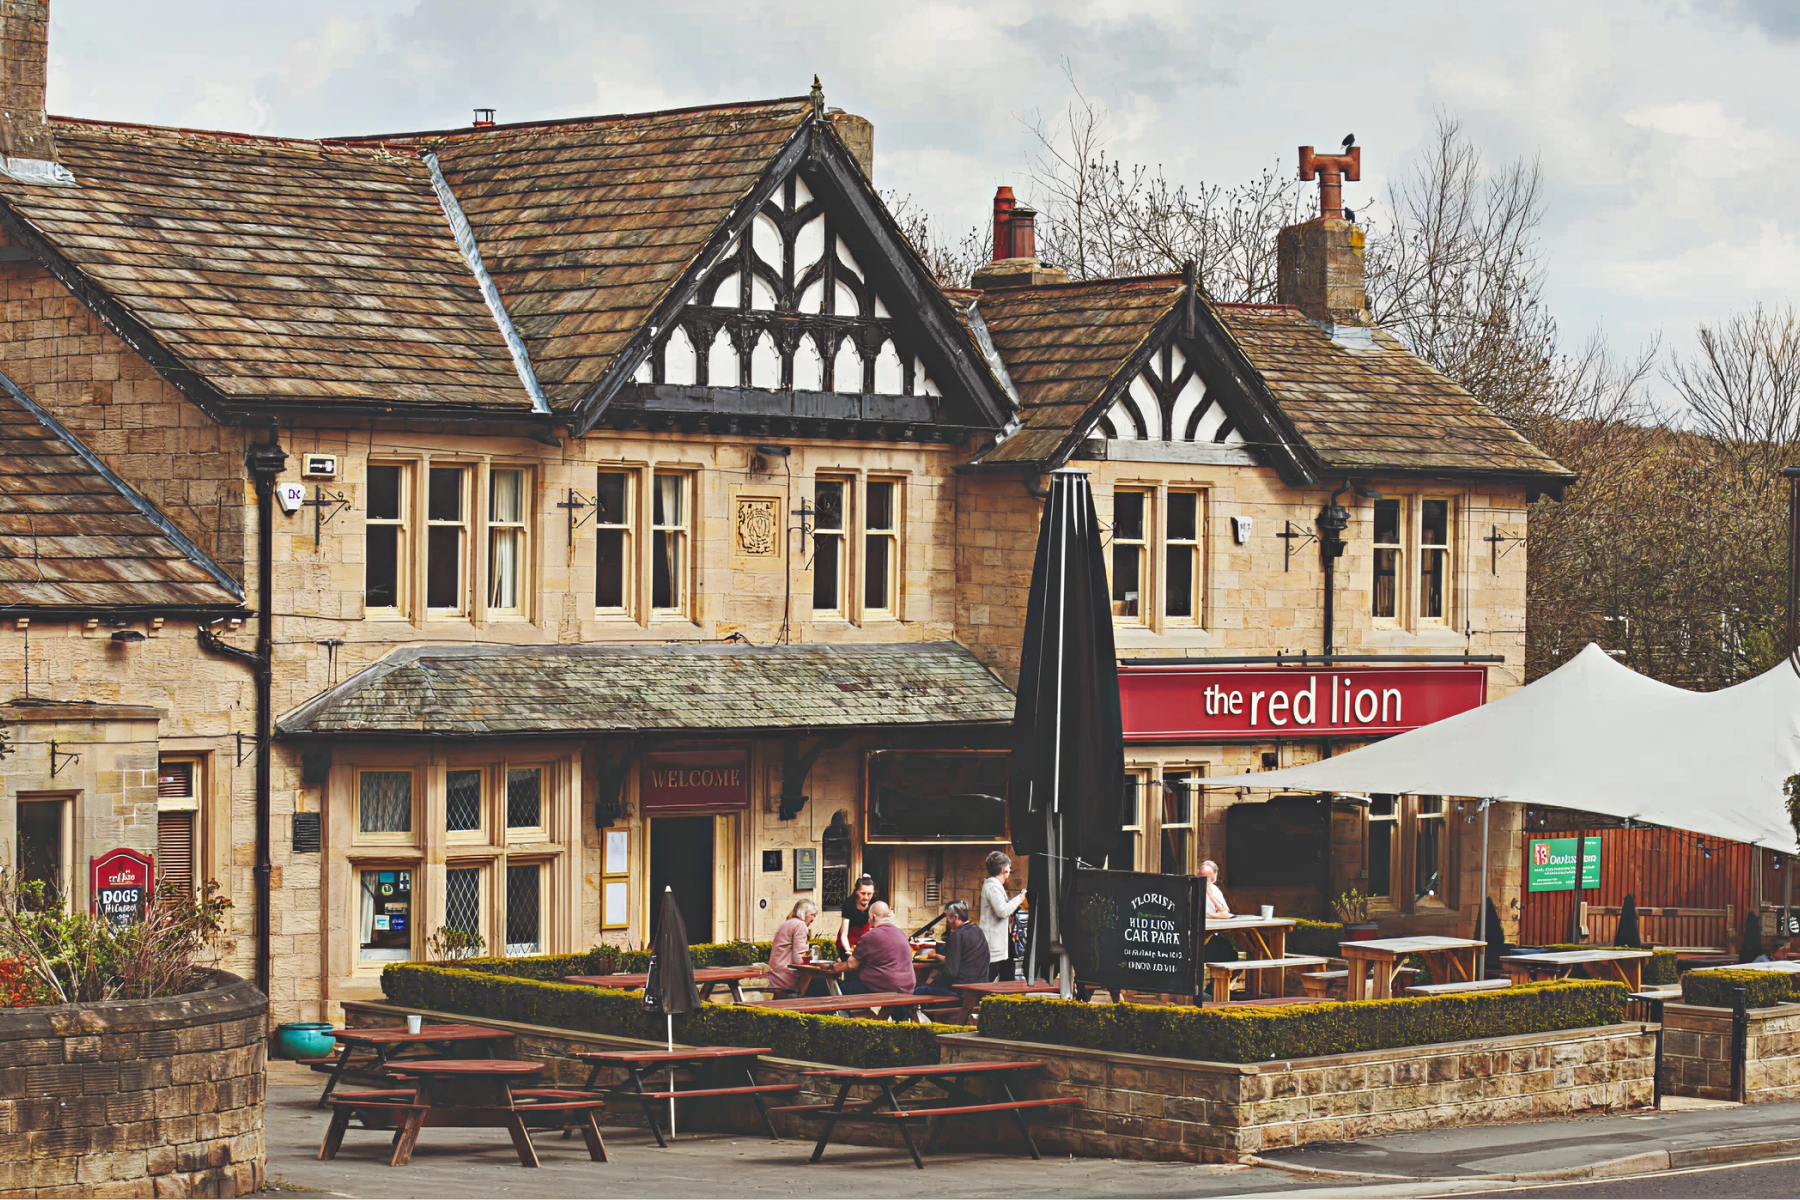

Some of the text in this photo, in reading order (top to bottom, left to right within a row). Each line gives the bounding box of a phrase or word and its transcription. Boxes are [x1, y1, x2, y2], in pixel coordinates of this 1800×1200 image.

[1204, 675, 1402, 726] the red lion
[652, 769, 740, 788] WELCOME
[102, 889, 138, 904] DOGS
[1124, 928, 1180, 945] CAR PARK
